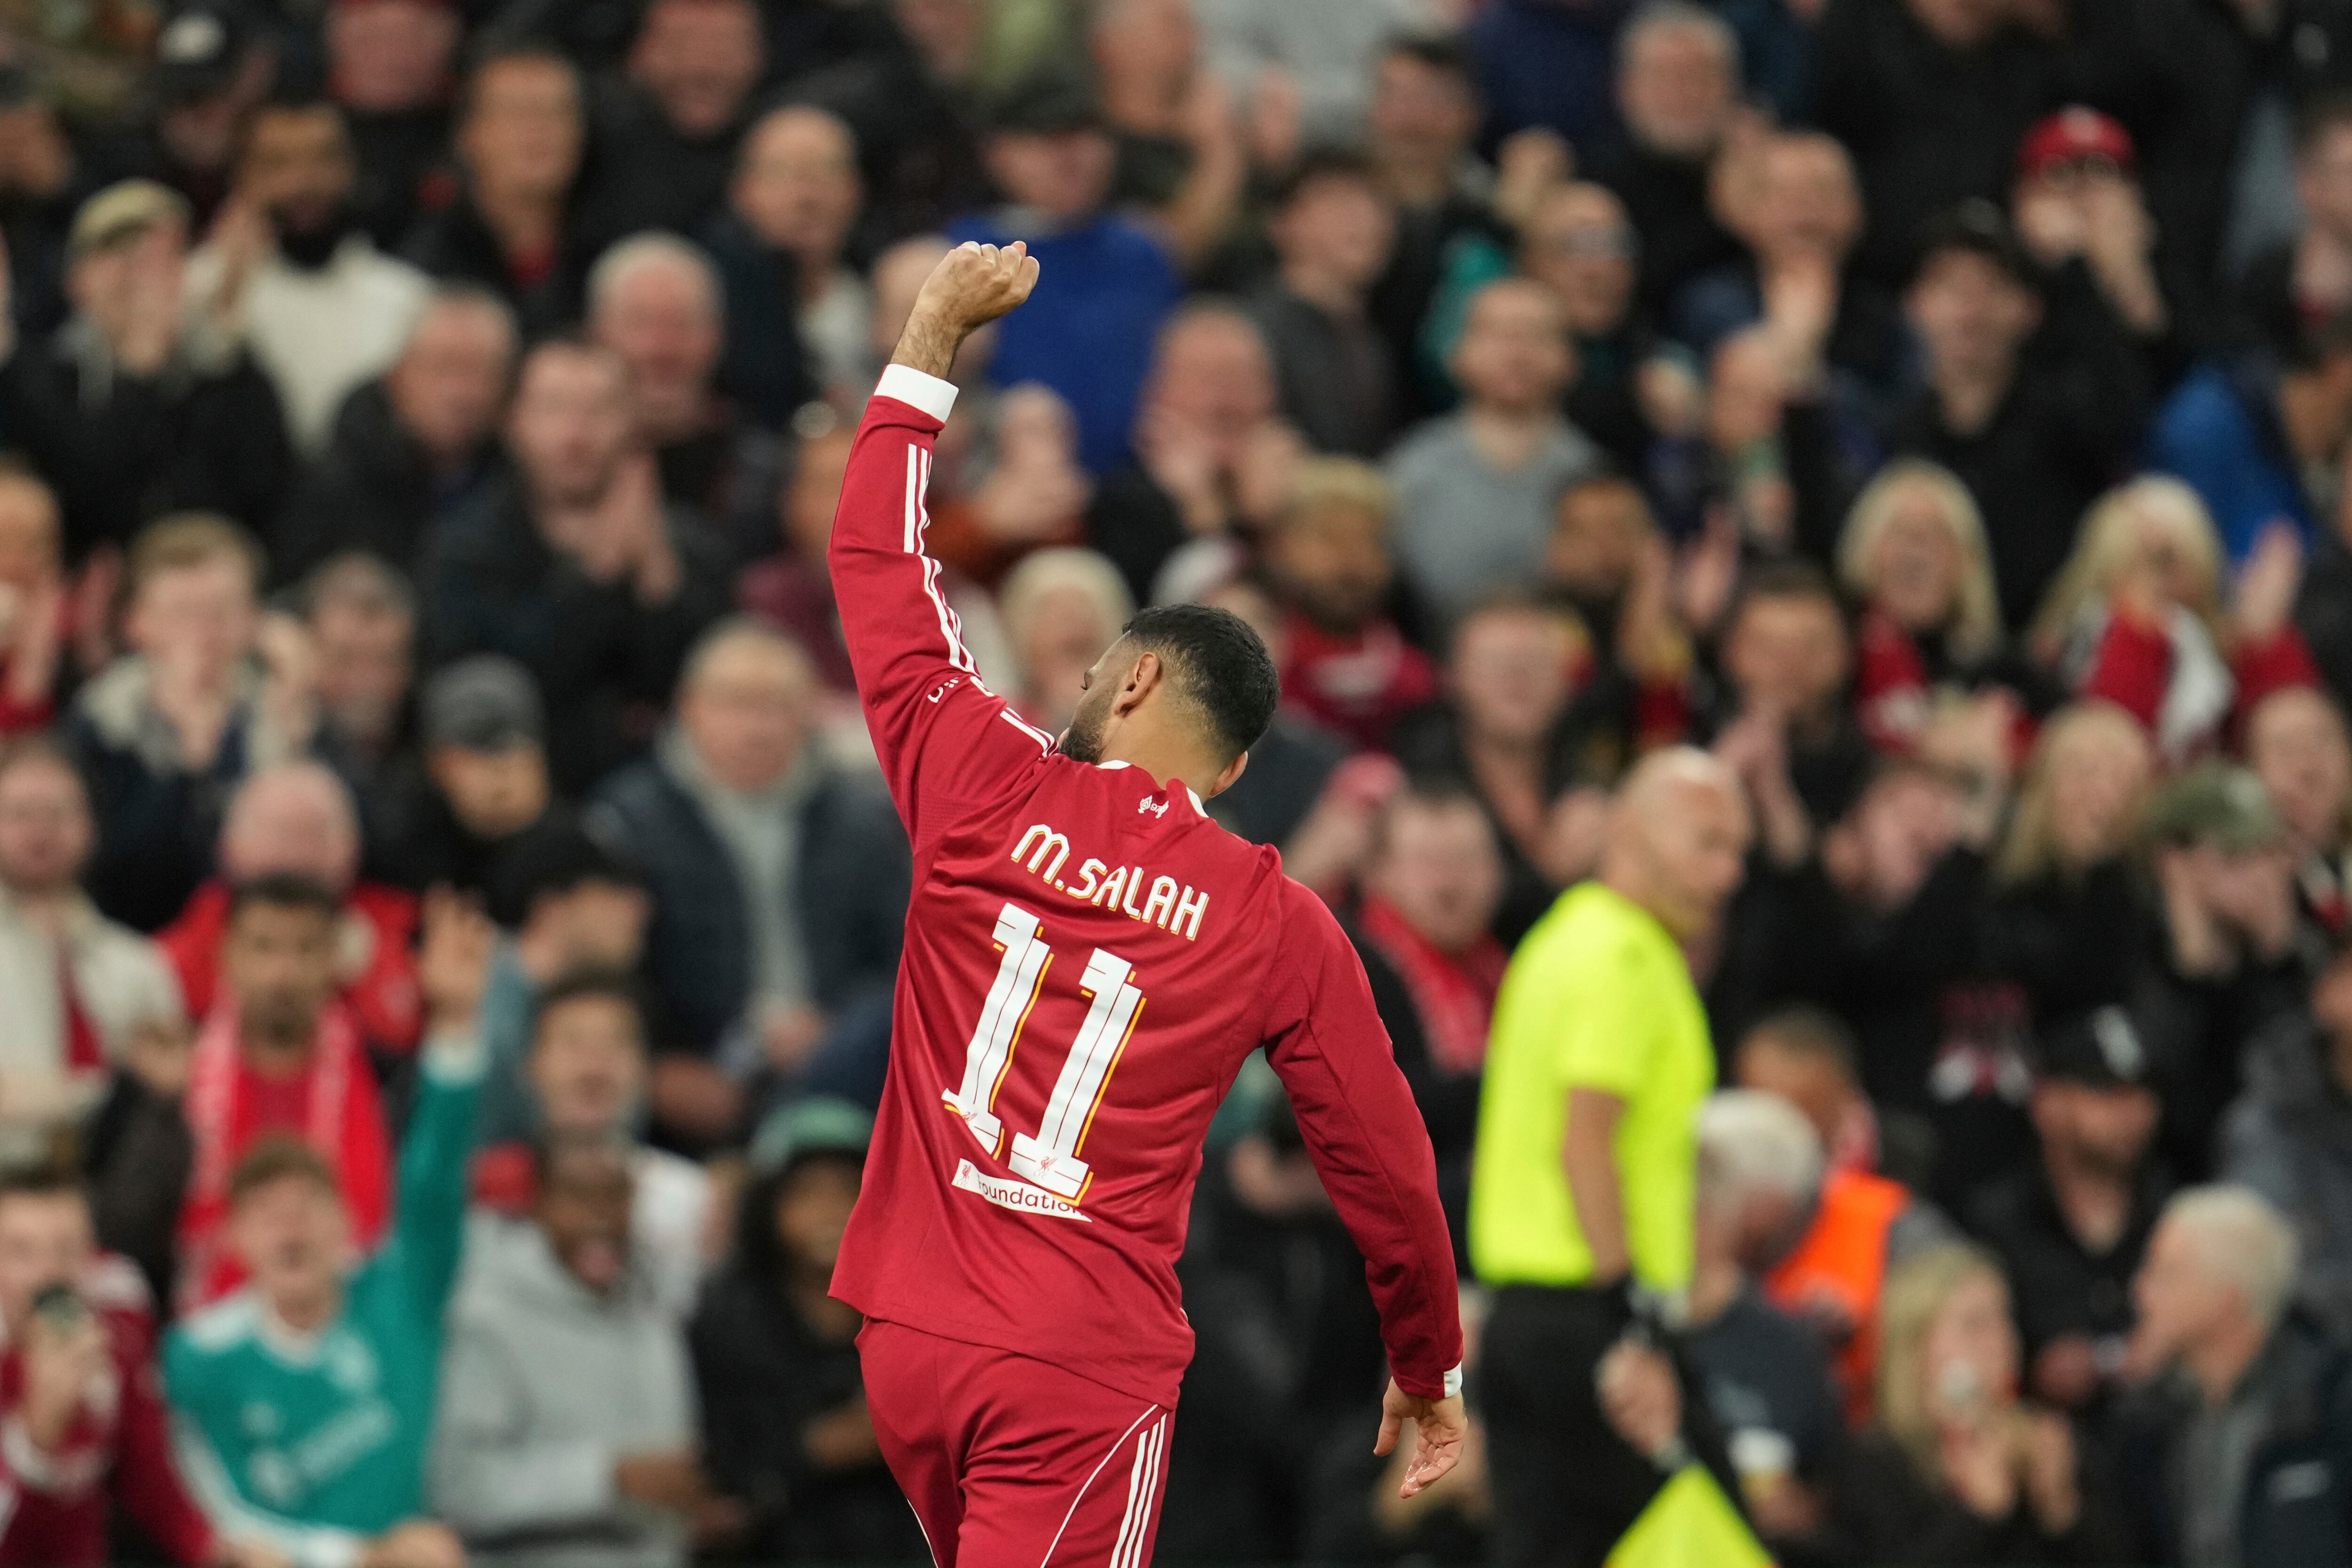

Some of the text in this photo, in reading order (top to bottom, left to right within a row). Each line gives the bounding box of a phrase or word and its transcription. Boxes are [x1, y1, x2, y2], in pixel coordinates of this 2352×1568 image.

[1010, 824, 1209, 940] M.SALAH
[941, 902, 1147, 1206] 11
[977, 1173, 1084, 1215] Foundatio
